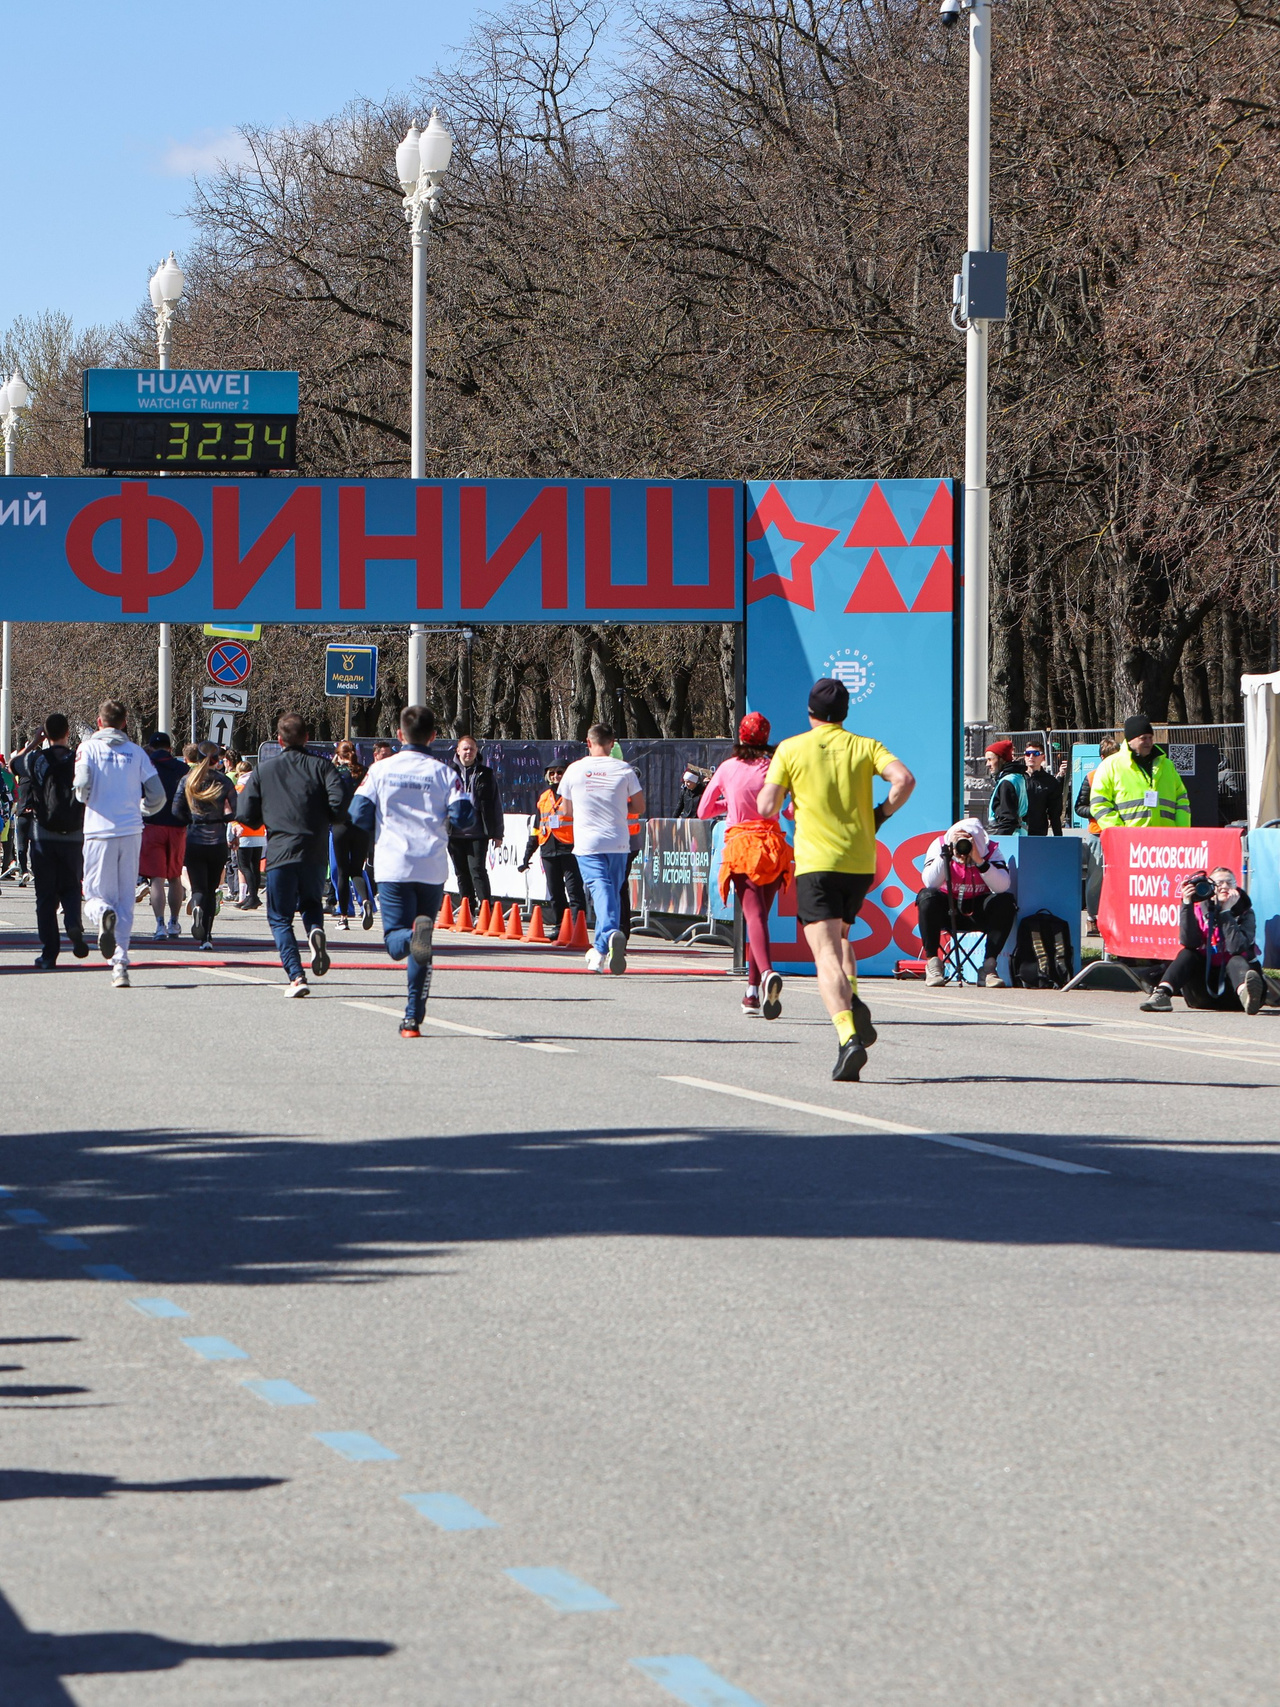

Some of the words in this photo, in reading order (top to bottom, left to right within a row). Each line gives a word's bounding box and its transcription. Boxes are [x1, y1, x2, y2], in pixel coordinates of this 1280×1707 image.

[137, 373, 250, 395] HUAWEI
[138, 398, 180, 409] WATCH
[182, 398, 197, 409] GT
[200, 399, 239, 410] Runner
[242, 400, 249, 410] 2
[65, 481, 735, 614] ФИНИШ
[332, 673, 364, 683] Медали
[663, 851, 679, 866] ТВОЯ
[680, 852, 709, 867] БЕГОВАЯ
[662, 869, 690, 884] ИСТОРИЯ
[1129, 874, 1160, 897] ПОЛУ
[1130, 936, 1154, 944] ВРЕМЯ
